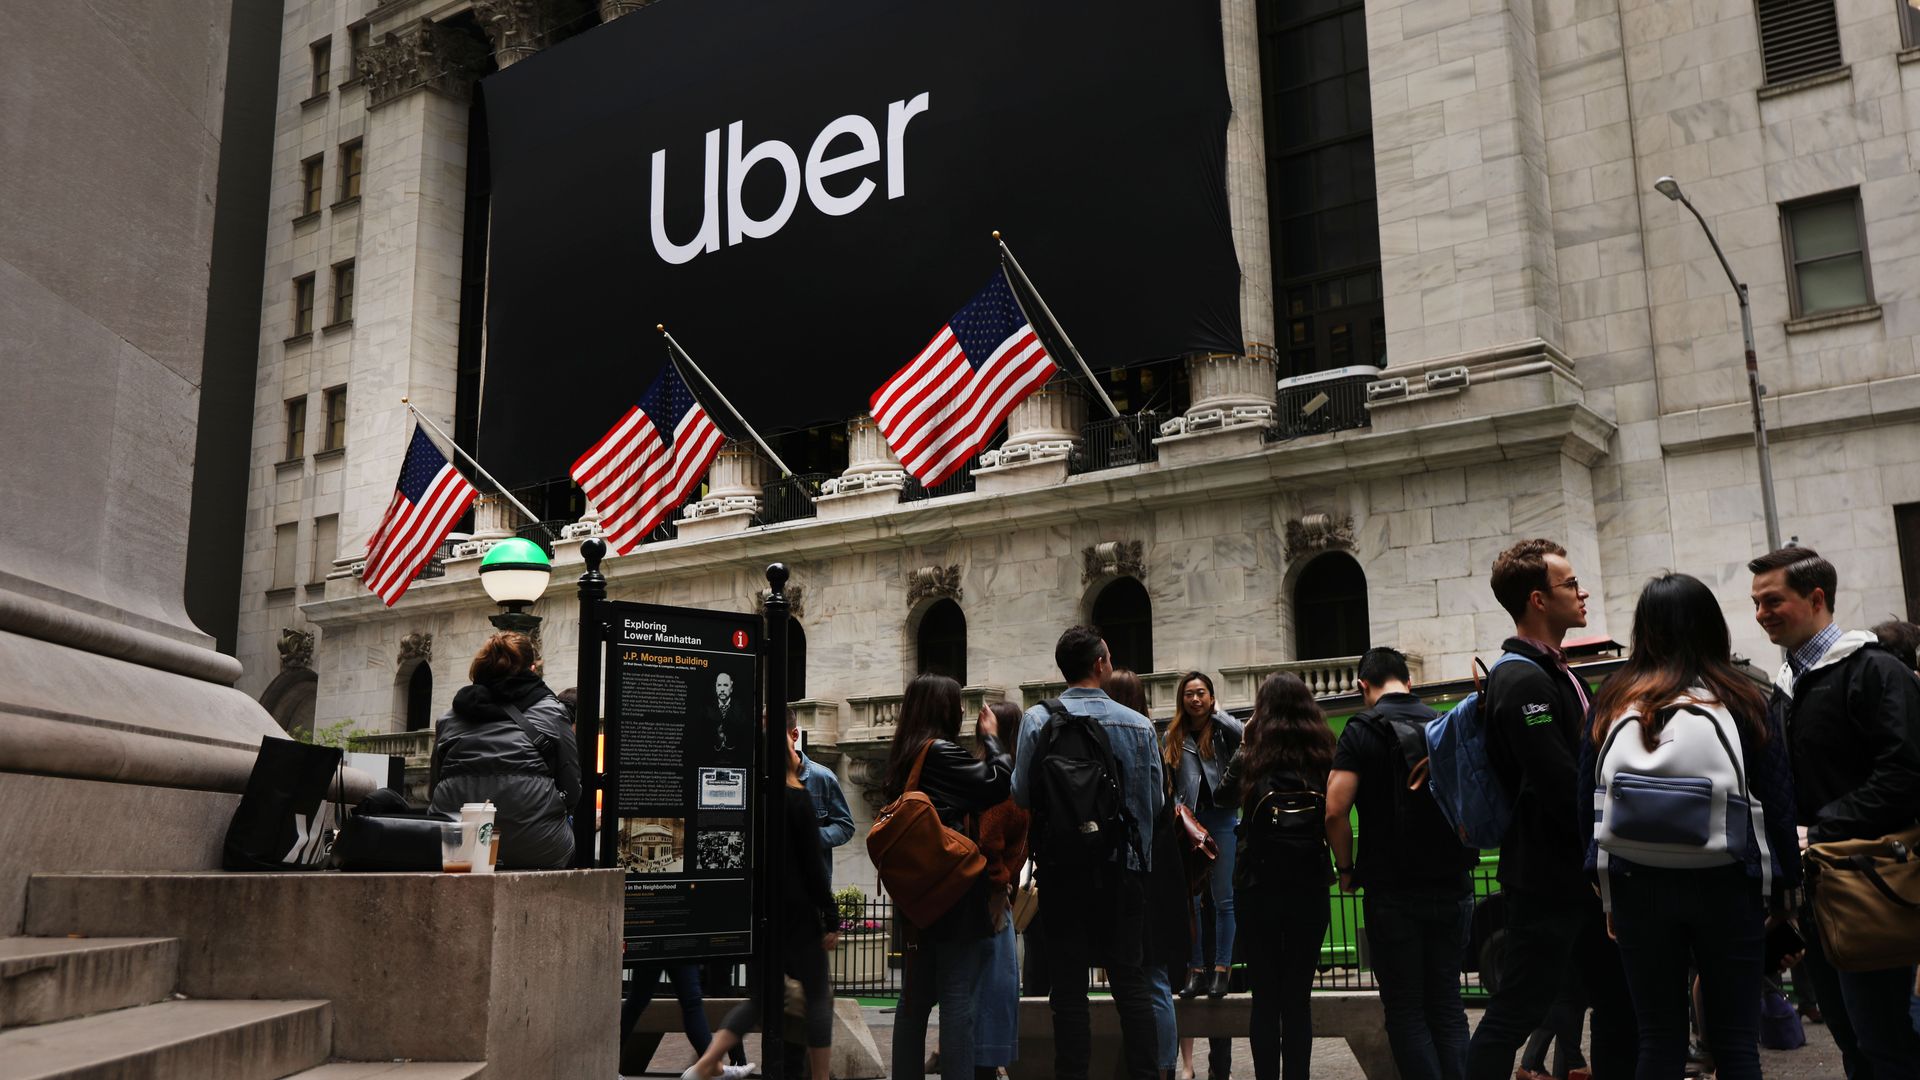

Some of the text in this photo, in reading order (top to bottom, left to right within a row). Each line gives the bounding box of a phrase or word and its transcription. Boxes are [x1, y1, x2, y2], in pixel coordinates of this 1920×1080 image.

[650, 91, 929, 265] Uber
[624, 619, 667, 633] Exploring
[624, 630, 702, 645] Lower Manhattan
[623, 652, 639, 661] J.P.
[640, 652, 673, 664] Morgan
[675, 655, 709, 668] Building
[642, 883, 677, 891] Neighborhood
